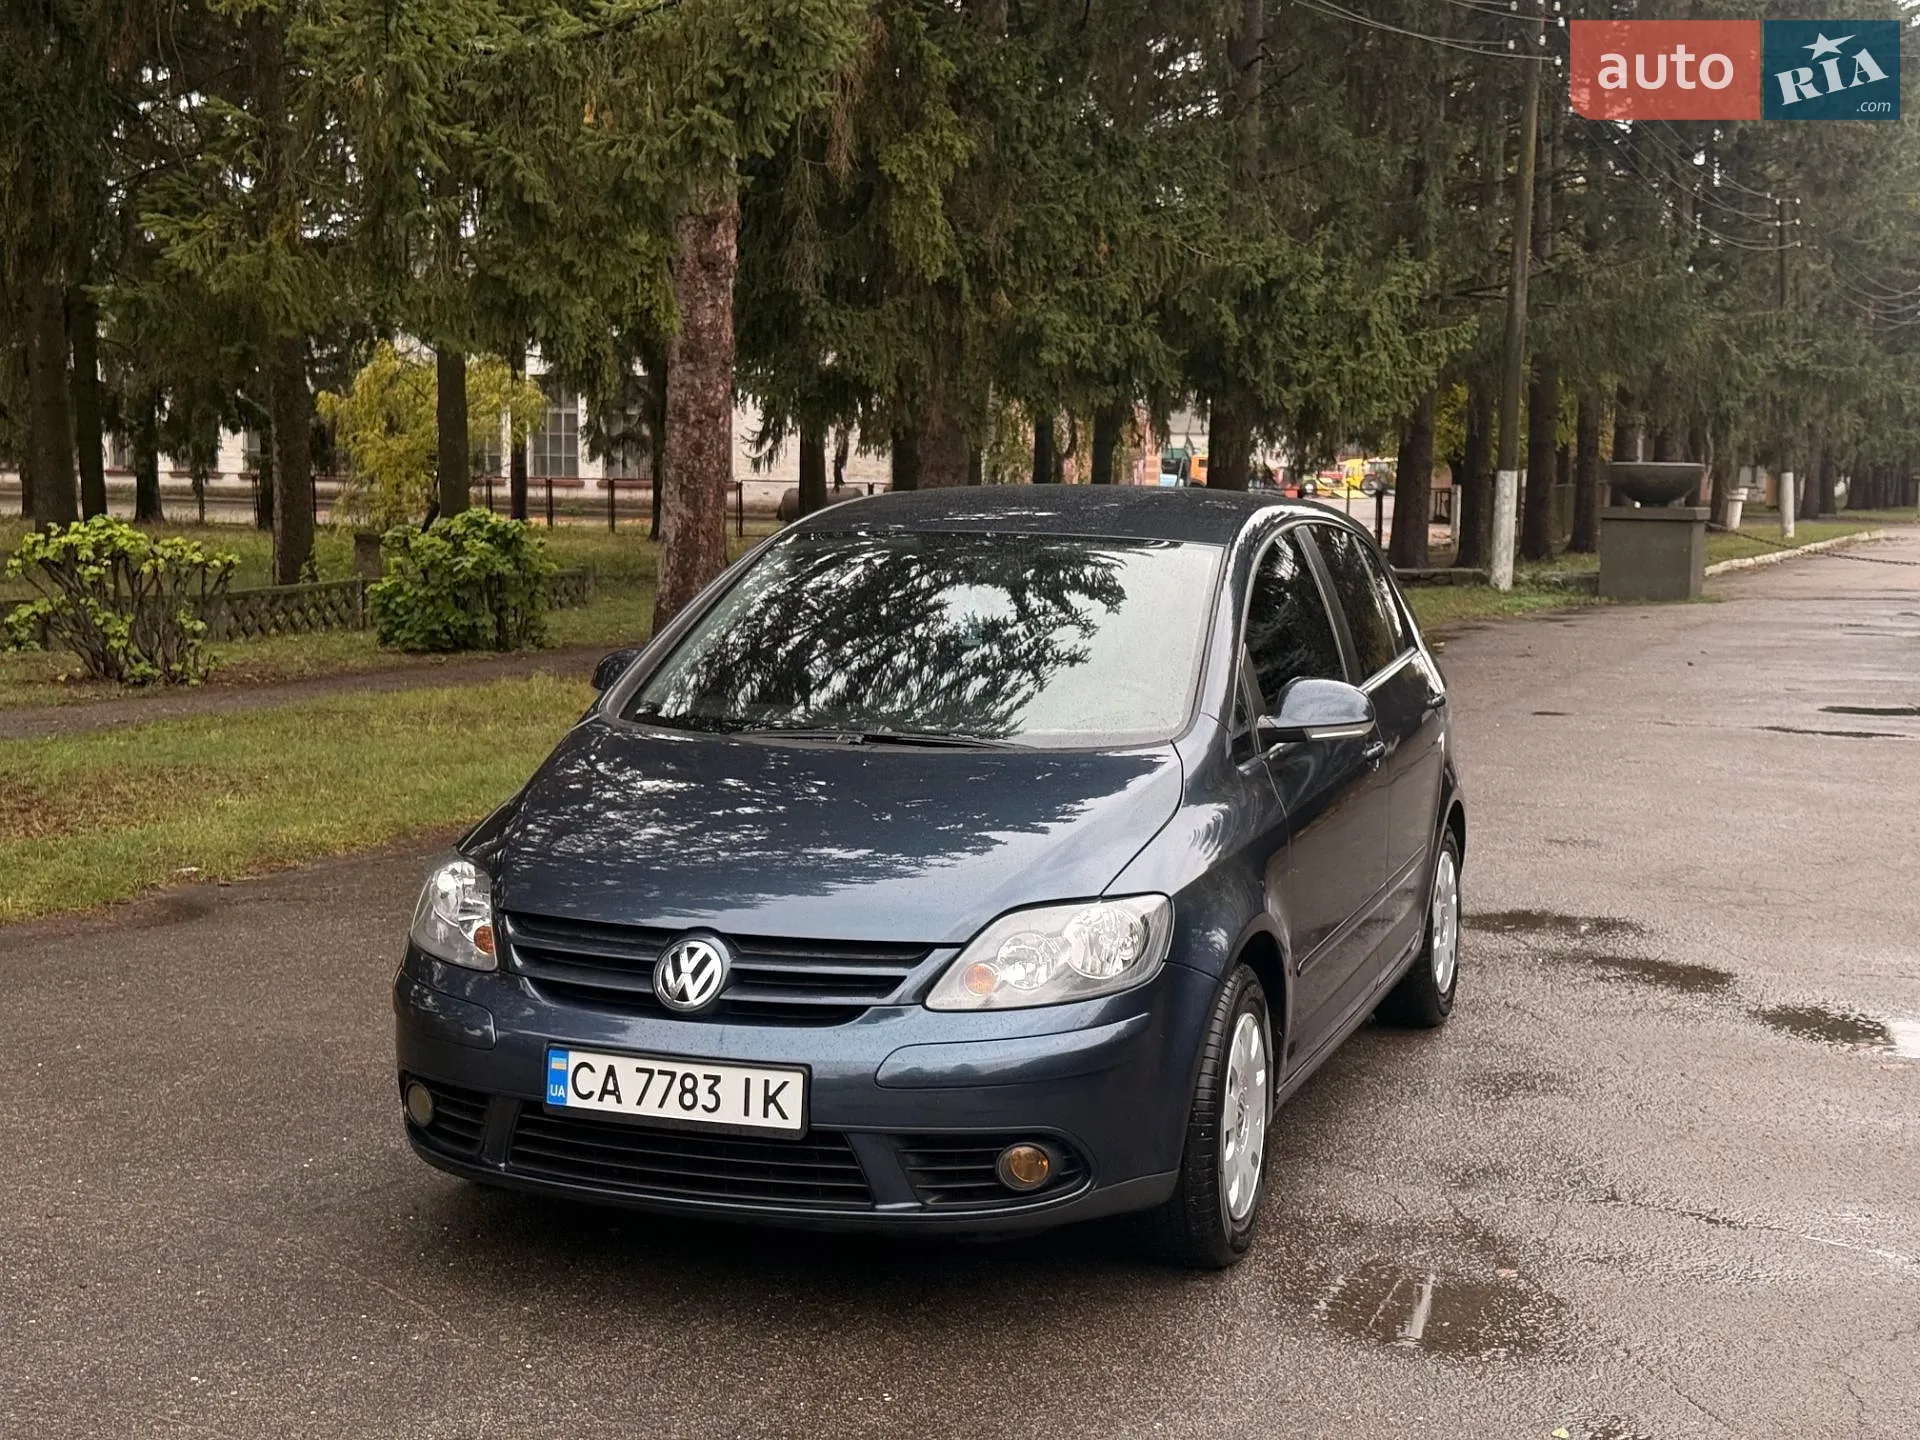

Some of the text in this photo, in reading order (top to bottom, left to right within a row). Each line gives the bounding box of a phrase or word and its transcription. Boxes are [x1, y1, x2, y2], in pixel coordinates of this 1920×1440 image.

[550, 1083, 566, 1098] UA
[571, 1061, 790, 1120] CA 7783 IK
